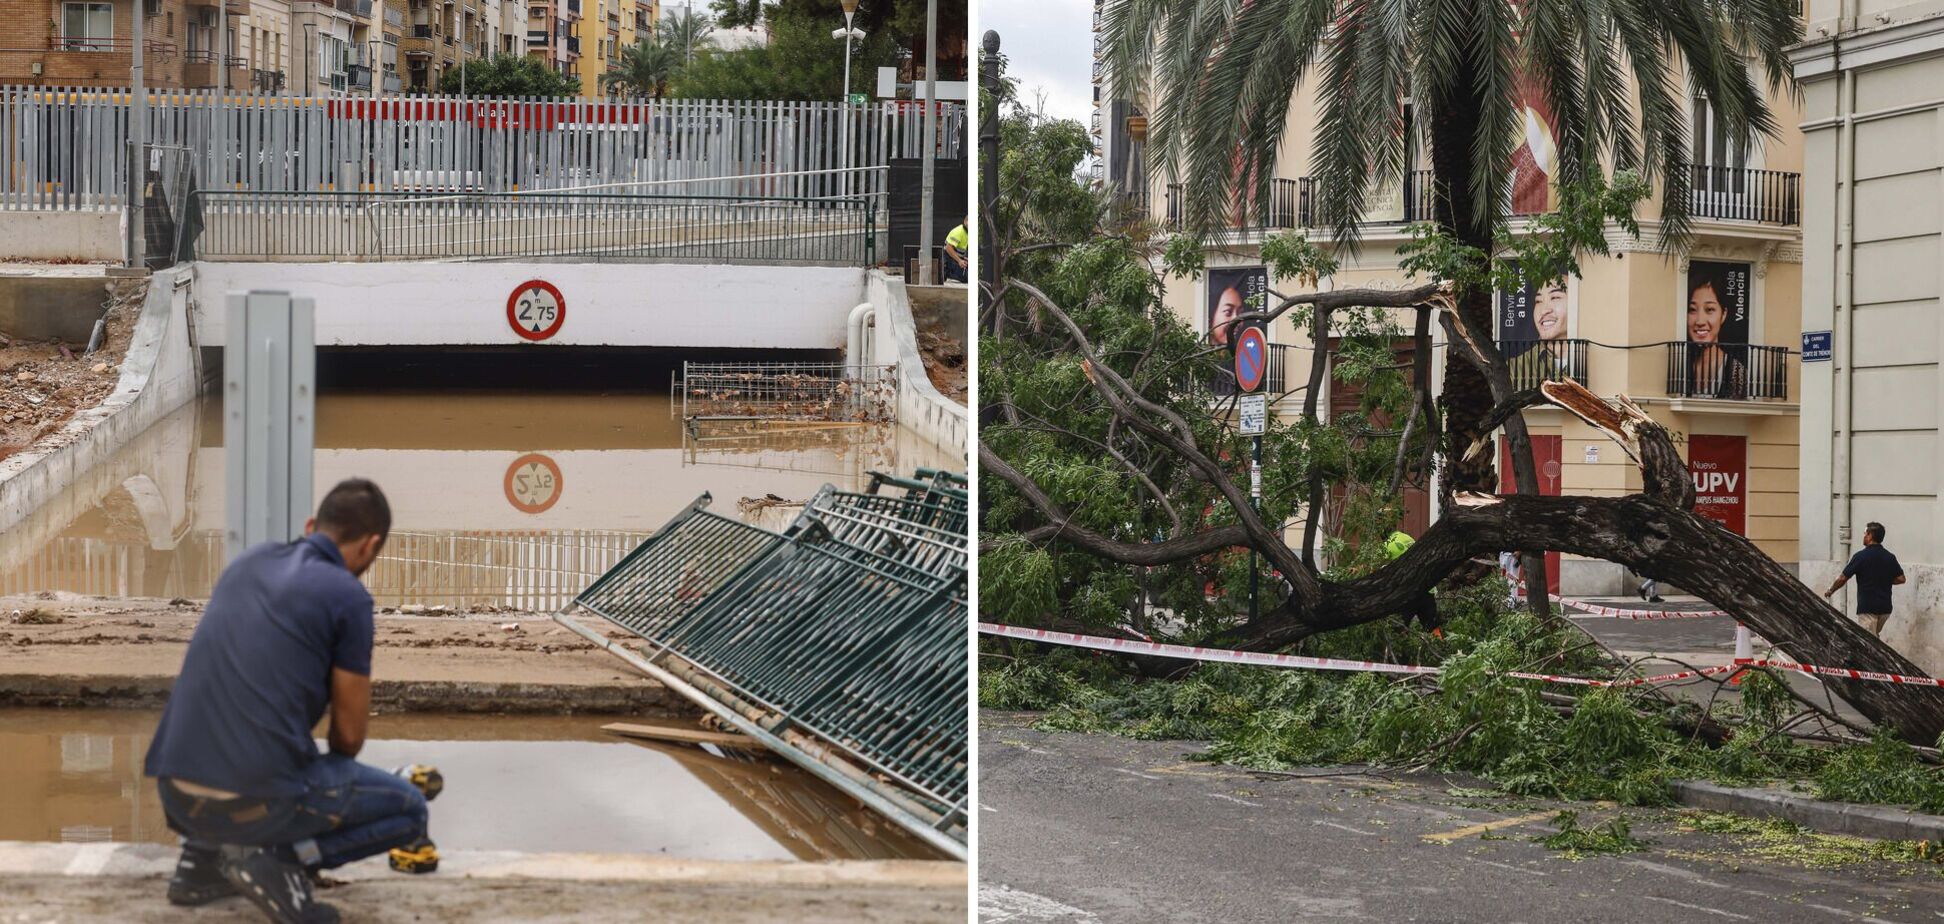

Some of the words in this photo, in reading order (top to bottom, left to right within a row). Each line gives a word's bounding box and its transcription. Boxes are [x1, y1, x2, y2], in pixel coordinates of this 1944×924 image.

[1247, 276, 1255, 298] Hola
[1727, 271, 1735, 296] Hola
[1516, 297, 1525, 307] la
[1735, 272, 1744, 321] Valencia
[1693, 460, 1717, 470] Nuevo
[1693, 472, 1739, 493] UPV
[1696, 496, 1712, 504] AMPUS
